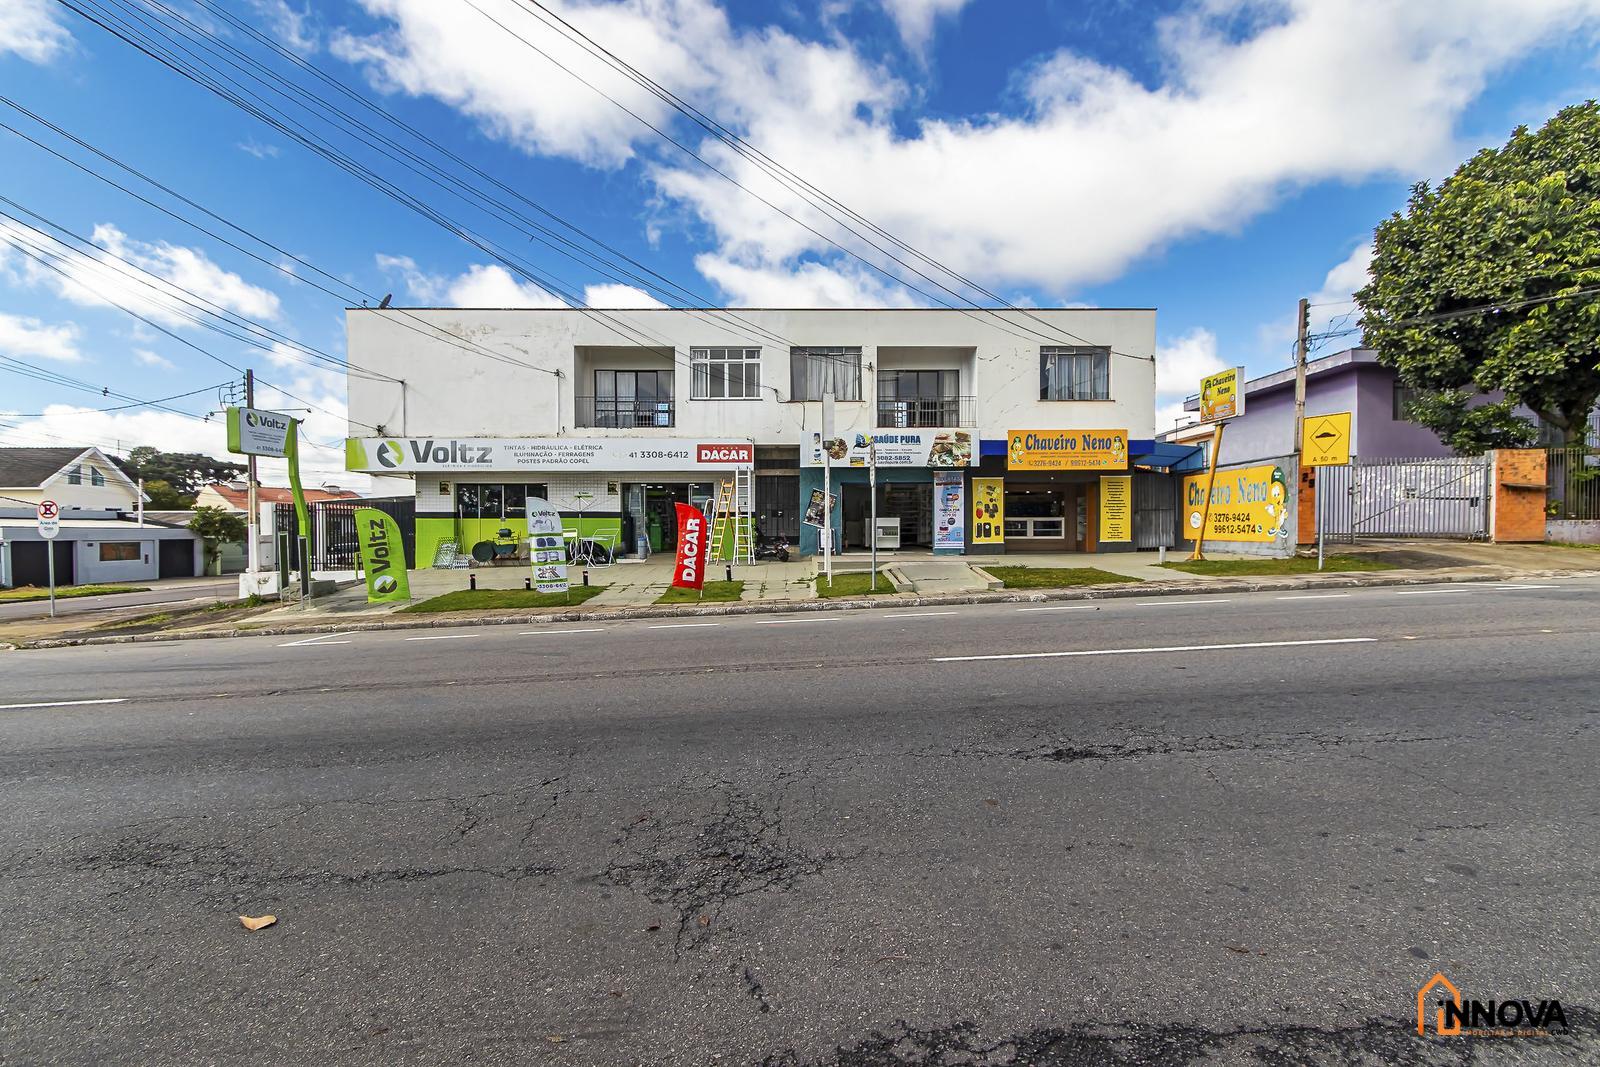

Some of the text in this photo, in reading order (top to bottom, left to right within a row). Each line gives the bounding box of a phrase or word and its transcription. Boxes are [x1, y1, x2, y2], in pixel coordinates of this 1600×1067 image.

[259, 416, 286, 430] Voltz
[873, 434, 921, 444] SAÚDE PURA
[1025, 434, 1112, 451] Chaveiro Neno
[409, 440, 493, 463] Voltz
[640, 450, 689, 459] 3308-6412
[701, 449, 748, 460] DACAR
[1188, 477, 1268, 506] Chaeiro Neno
[1213, 512, 1251, 523] 3276-9424
[1214, 523, 1256, 534] 99612-5474
[368, 518, 391, 574] Voltz
[682, 518, 700, 582] DACAR
